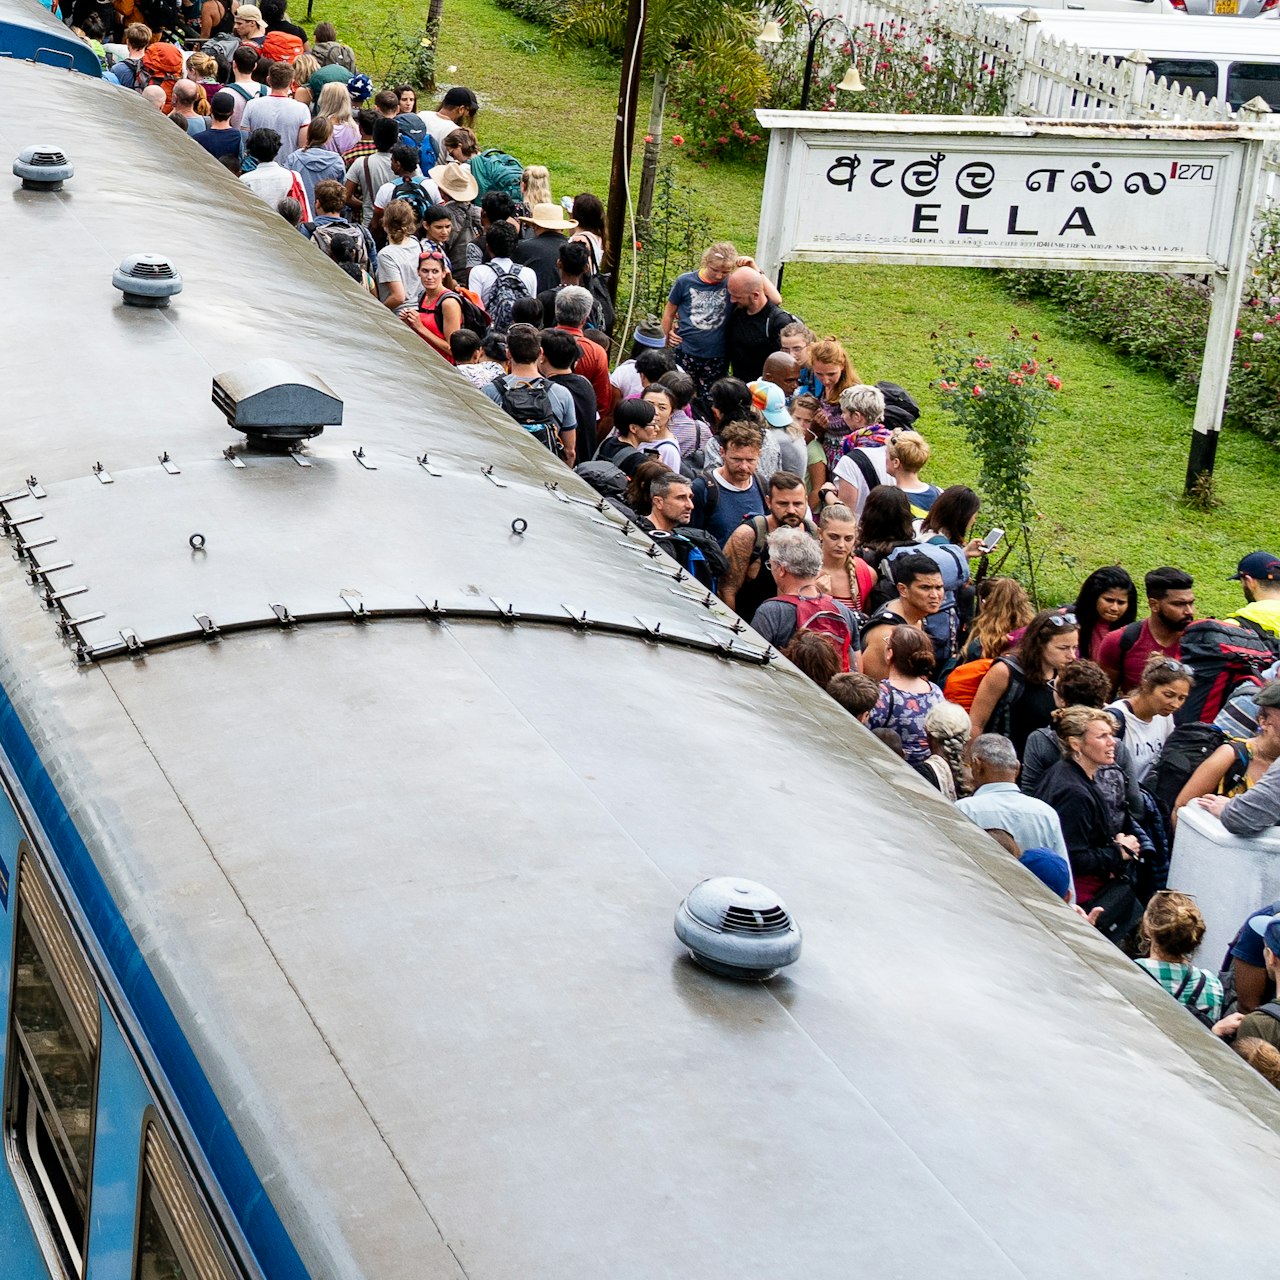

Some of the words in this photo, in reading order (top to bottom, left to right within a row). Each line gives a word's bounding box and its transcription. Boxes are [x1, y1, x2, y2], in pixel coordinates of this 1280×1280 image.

[826, 151, 996, 199] ඇල්ල
[1025, 161, 1167, 195] எல்ல
[1177, 164, 1214, 181] 270
[912, 203, 1096, 236] ELLA
